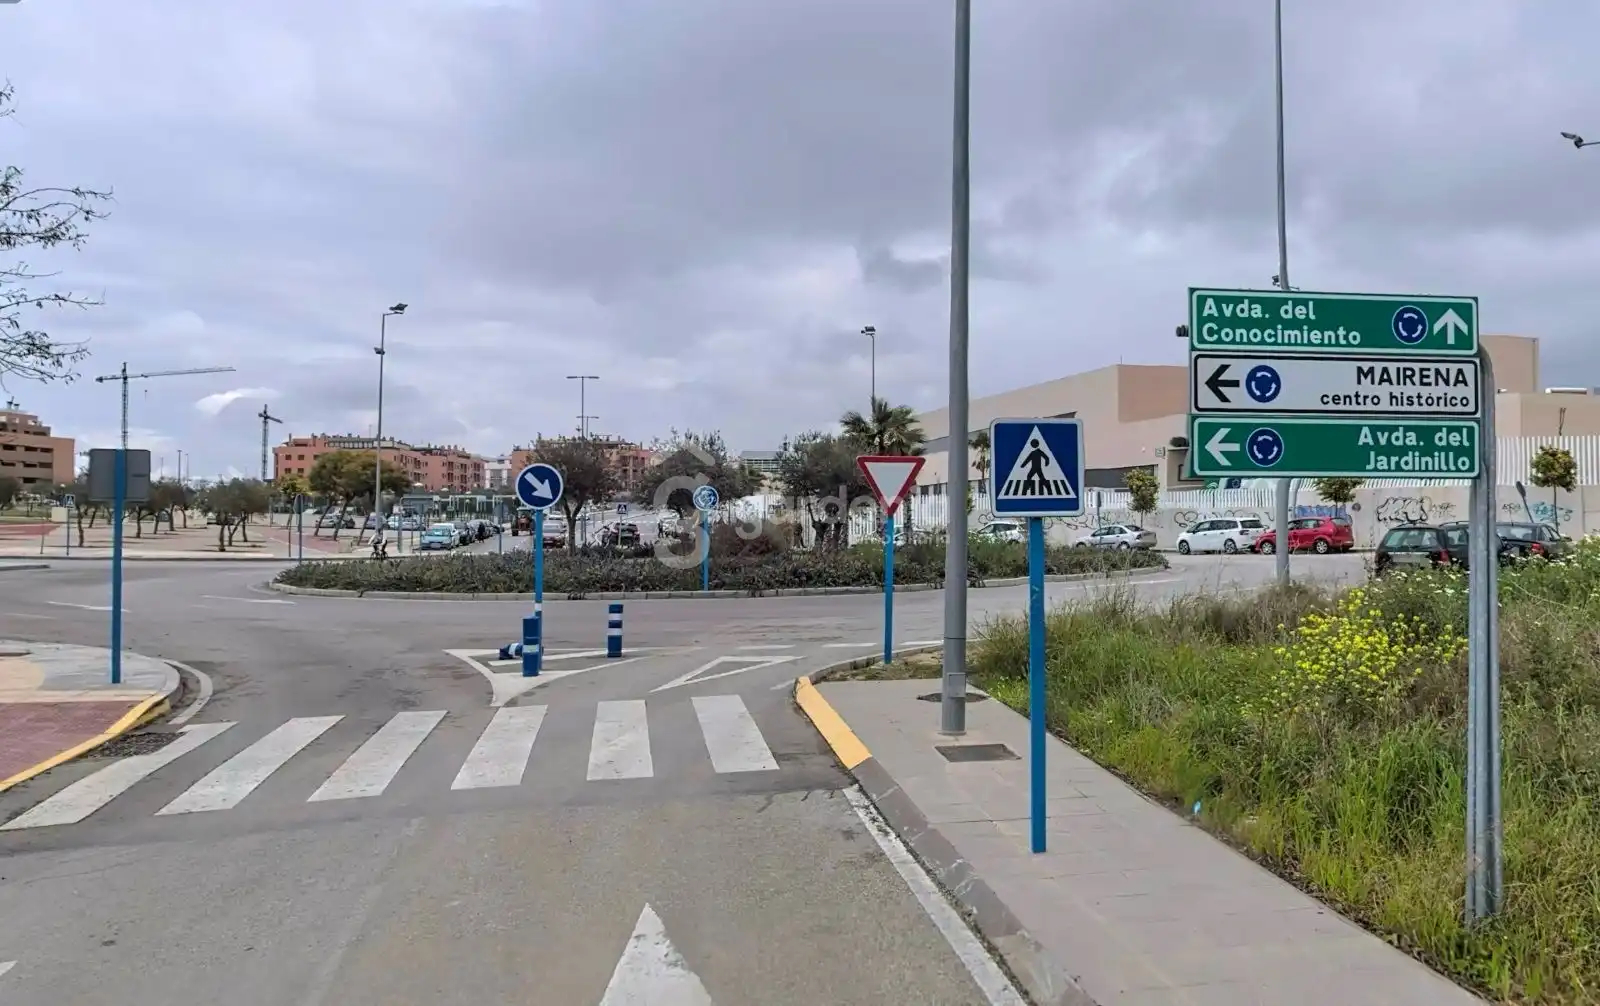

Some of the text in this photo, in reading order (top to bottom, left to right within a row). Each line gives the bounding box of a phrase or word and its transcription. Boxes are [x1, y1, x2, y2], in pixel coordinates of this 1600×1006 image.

[1202, 298, 1316, 320] Avda. del
[1202, 323, 1361, 346] Conocimiento
[1356, 365, 1469, 387] MAIRENA
[1320, 390, 1381, 406] centro
[1357, 425, 1470, 447] Avda. del
[1365, 450, 1470, 472] Jardinillo
